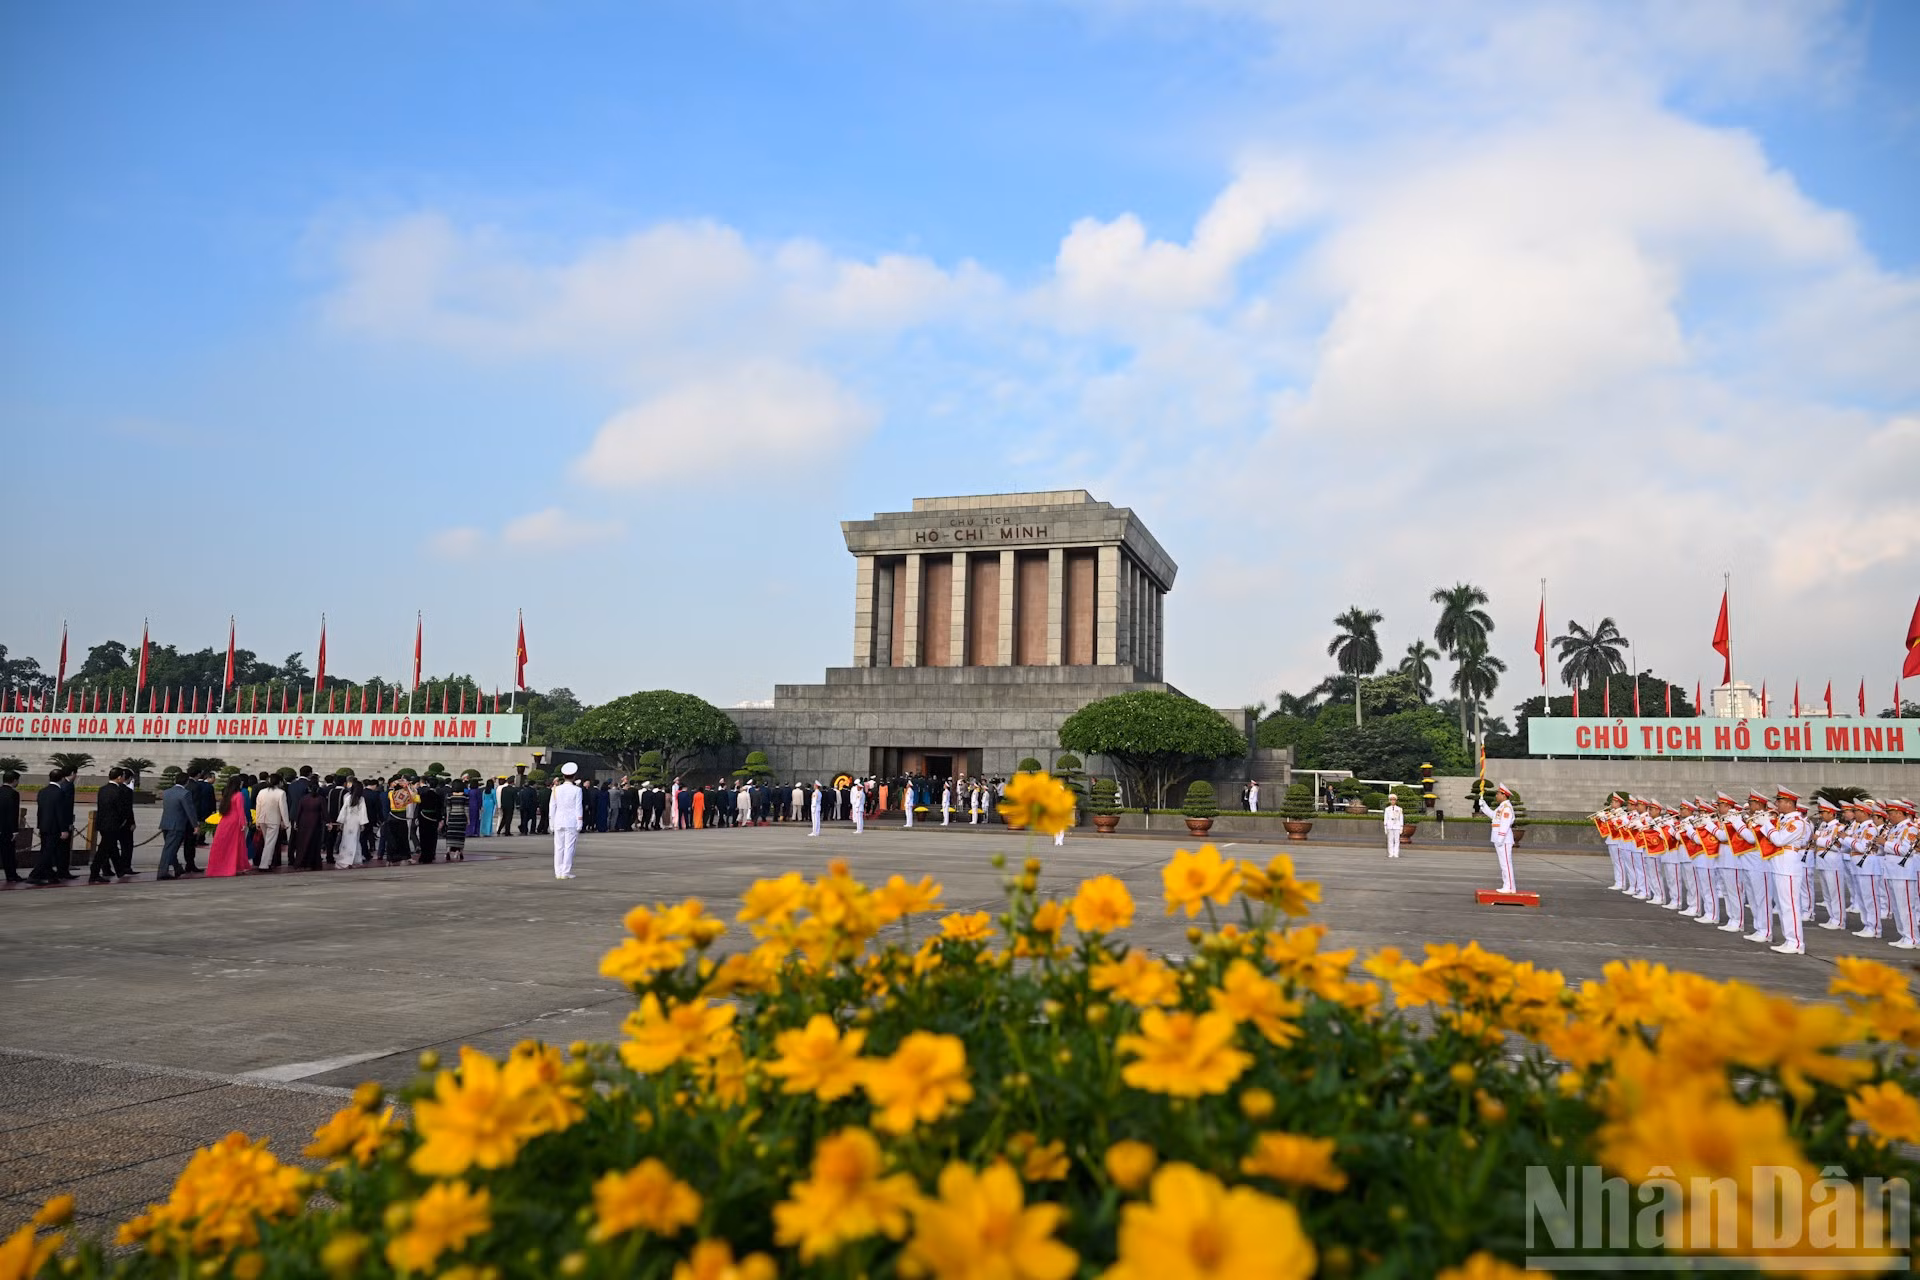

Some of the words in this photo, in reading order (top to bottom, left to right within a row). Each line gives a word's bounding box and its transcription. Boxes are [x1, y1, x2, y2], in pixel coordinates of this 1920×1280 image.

[31, 715, 72, 737] CỘNG
[77, 715, 109, 735] HÒA
[115, 716, 136, 735] XÃ
[142, 715, 170, 738] HỘI
[176, 714, 210, 735] CHỦ
[216, 716, 269, 736] NGHĨA
[277, 716, 315, 739] VIỆT
[321, 719, 363, 737] NAM
[370, 716, 426, 737] MUÔN
[433, 716, 477, 738] NĂM
[485, 720, 493, 738] !
[1576, 719, 1629, 749] CHỦ
[1640, 726, 1703, 754] TỊCH
[1714, 718, 1751, 750] HỒ
[1764, 722, 1813, 751] CHÍ
[1826, 727, 1905, 752] MINH
